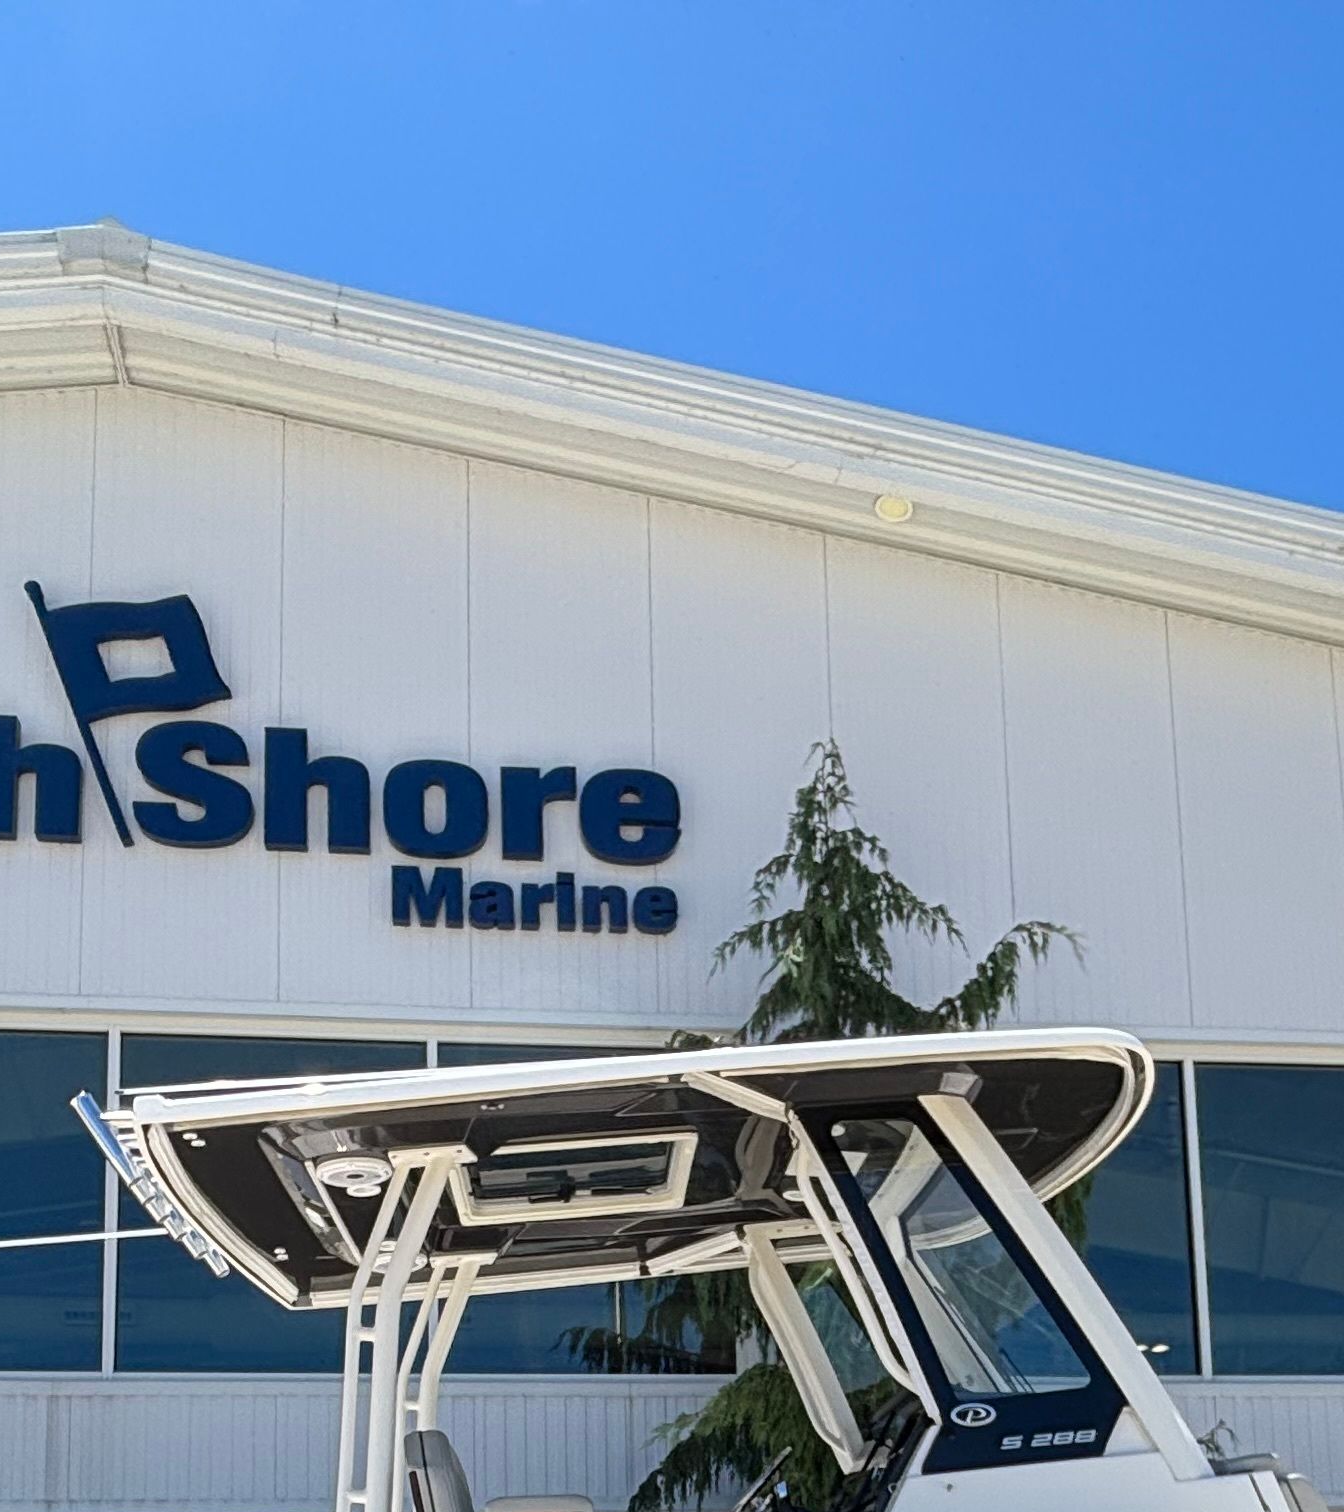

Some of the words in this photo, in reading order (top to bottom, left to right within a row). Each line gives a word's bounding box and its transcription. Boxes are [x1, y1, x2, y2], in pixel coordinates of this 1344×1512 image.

[131, 719, 683, 866] Shore
[390, 864, 680, 935] Marine
[1000, 1435, 1023, 1450] S
[1031, 1429, 1097, 1447] 288
